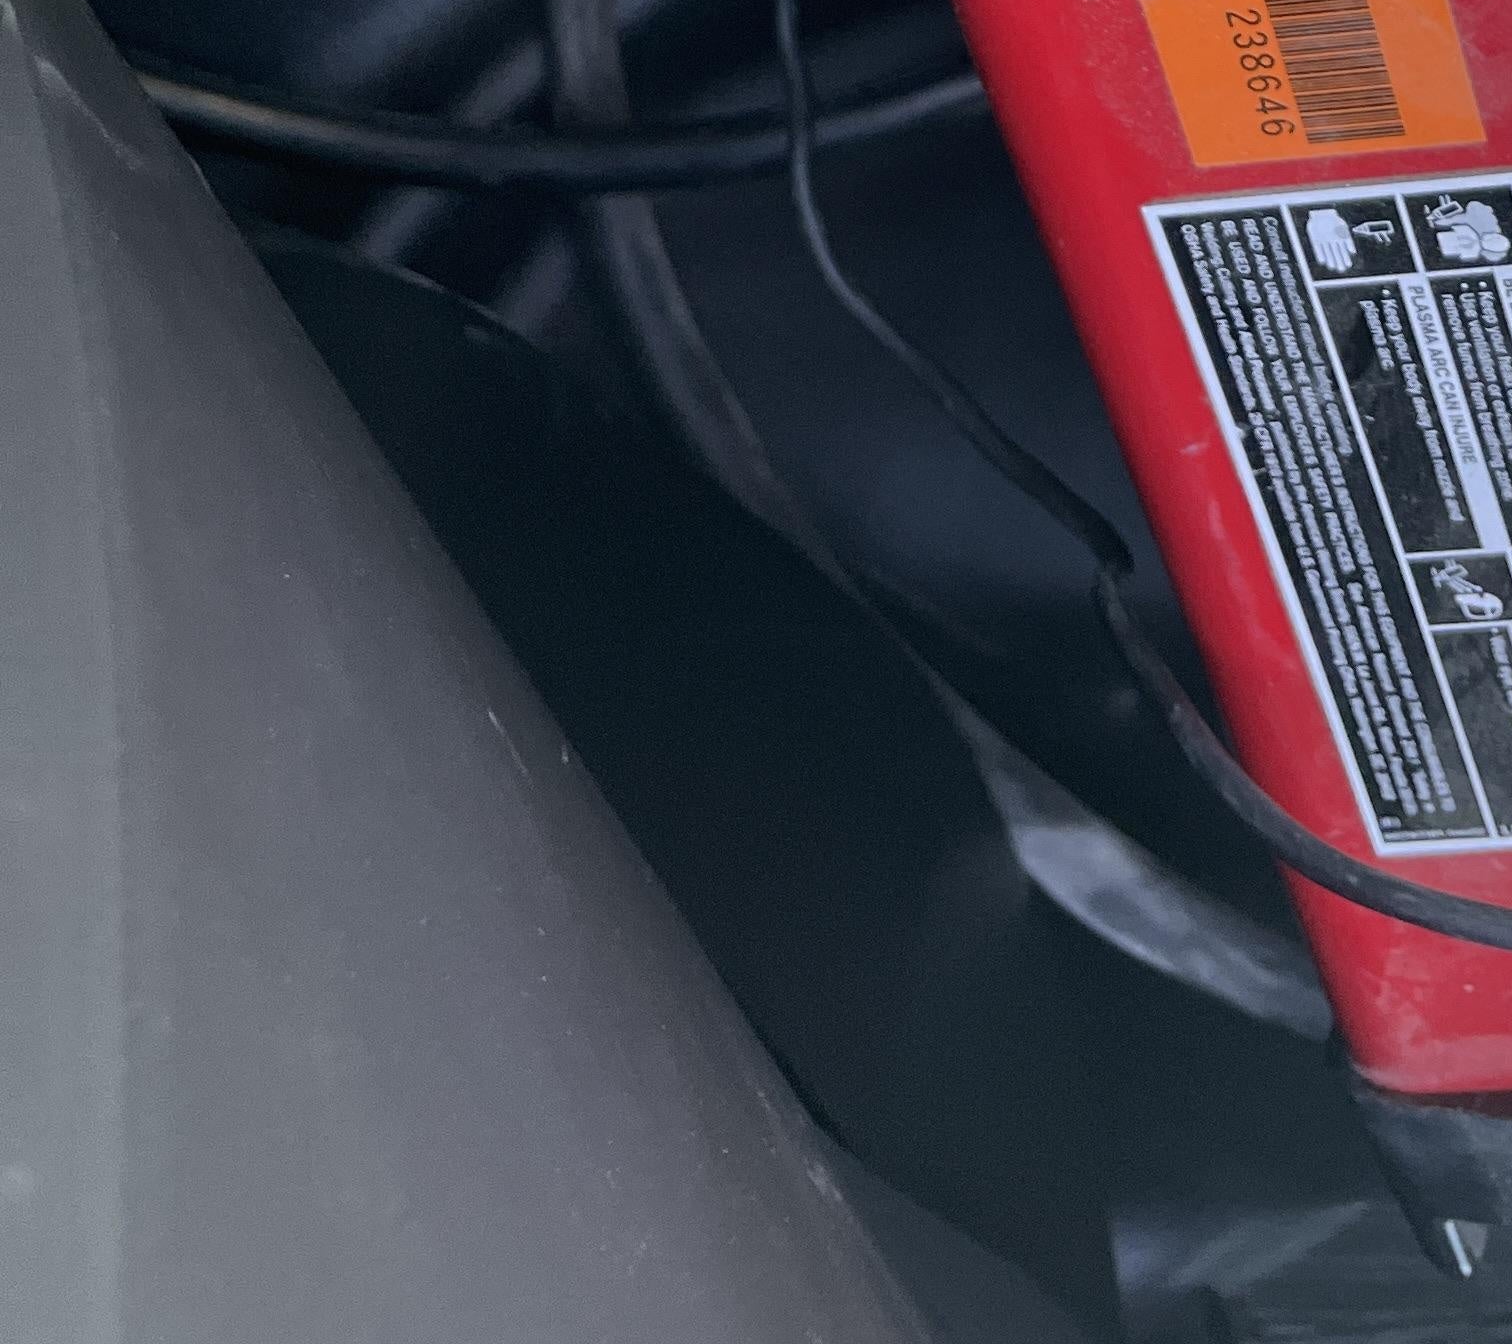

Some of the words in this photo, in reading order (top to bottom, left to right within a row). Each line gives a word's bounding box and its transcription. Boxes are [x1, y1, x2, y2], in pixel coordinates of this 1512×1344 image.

[1225, 9, 1295, 137] 238646
[1407, 285, 1440, 344] PLASMA
[1427, 347, 1451, 377] ARC
[1439, 380, 1461, 410] CAN
[1449, 414, 1478, 464] INJURE
